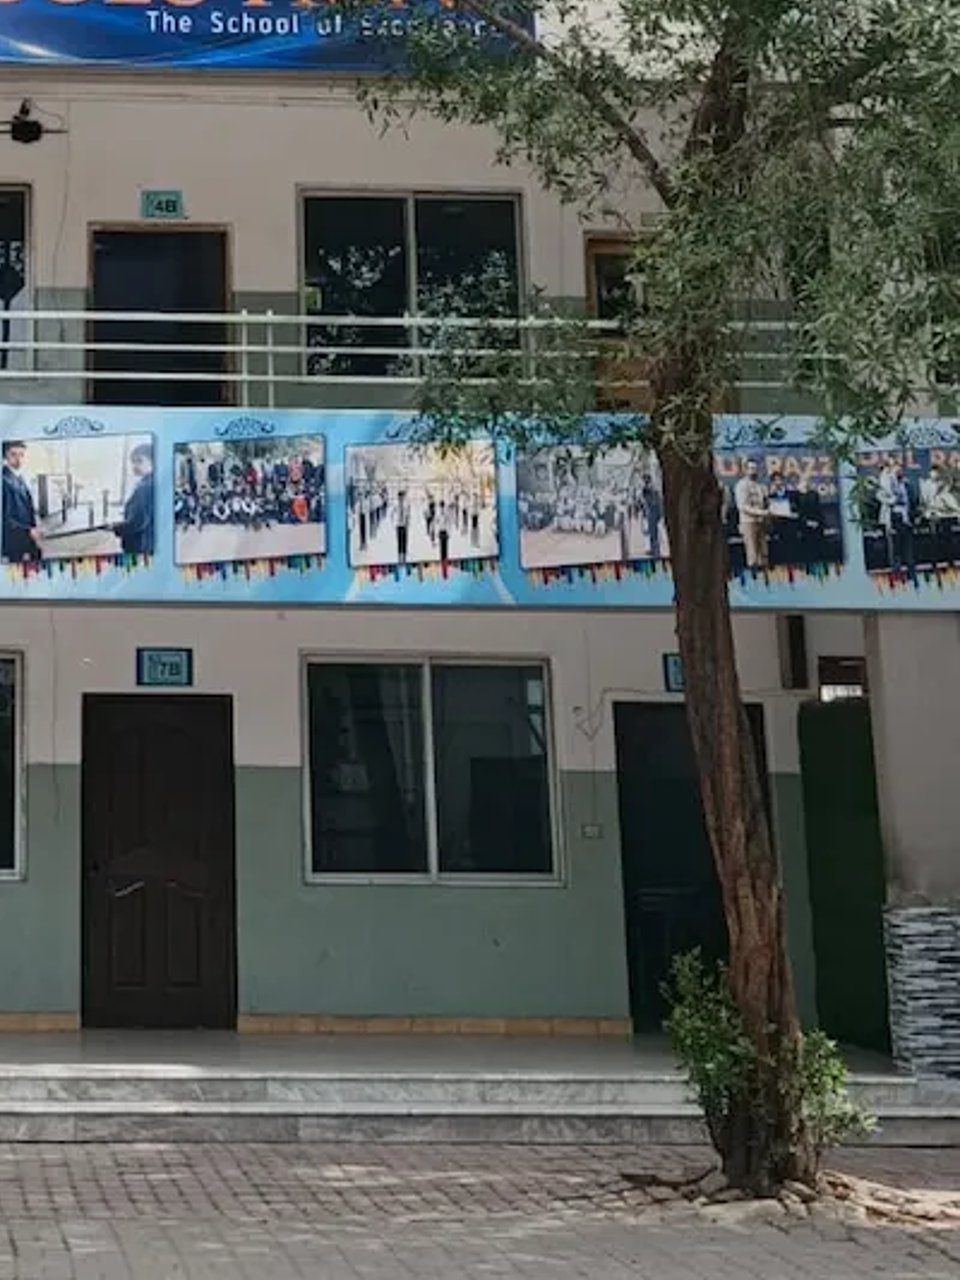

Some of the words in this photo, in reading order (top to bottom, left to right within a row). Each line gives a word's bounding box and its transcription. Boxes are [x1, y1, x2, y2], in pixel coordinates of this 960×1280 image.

[145, 10, 192, 34] The
[210, 10, 299, 35] School
[153, 199, 178, 213] 4B
